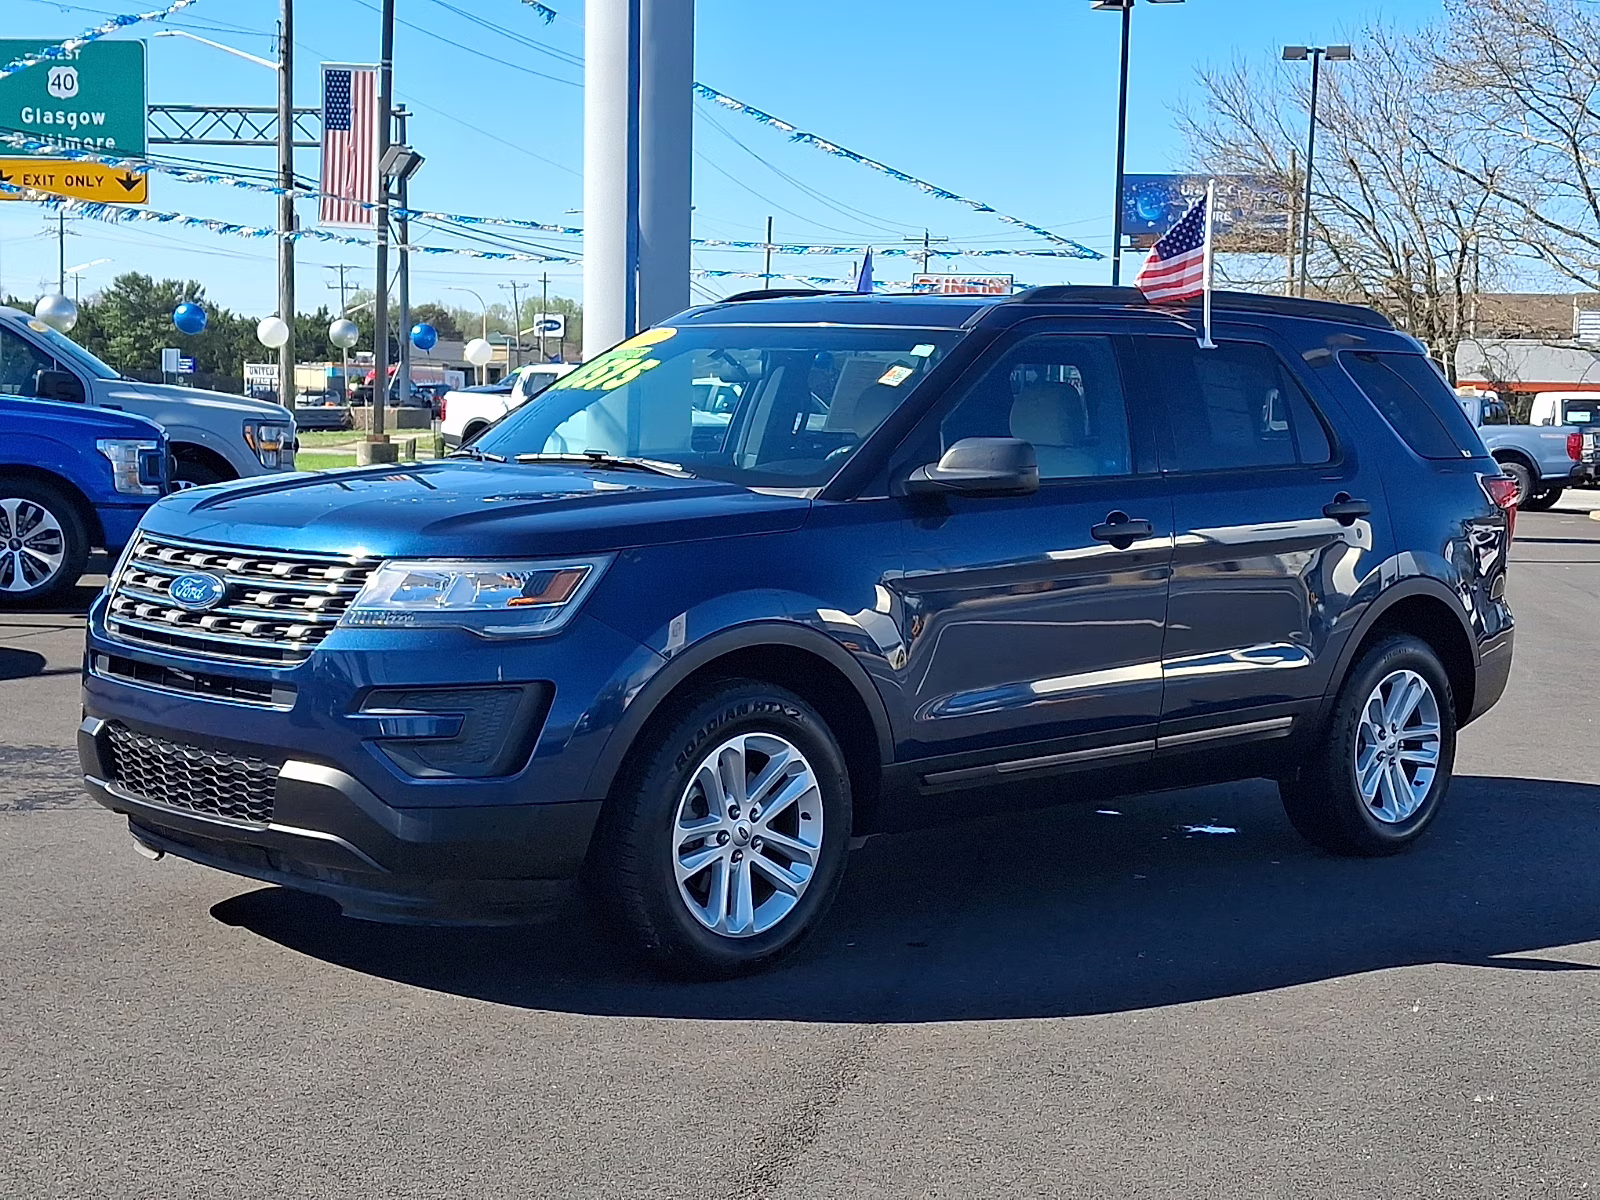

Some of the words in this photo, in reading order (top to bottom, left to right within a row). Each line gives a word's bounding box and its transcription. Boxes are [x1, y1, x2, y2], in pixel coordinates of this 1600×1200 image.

[44, 49, 81, 60] EST
[50, 73, 75, 91] 40
[21, 106, 106, 130] Glasgow
[23, 174, 55, 186] EXIT
[65, 175, 105, 187] ONLY
[249, 366, 275, 376] UNITED
[175, 577, 207, 600] Ford
[674, 702, 749, 772] ROADIAN
